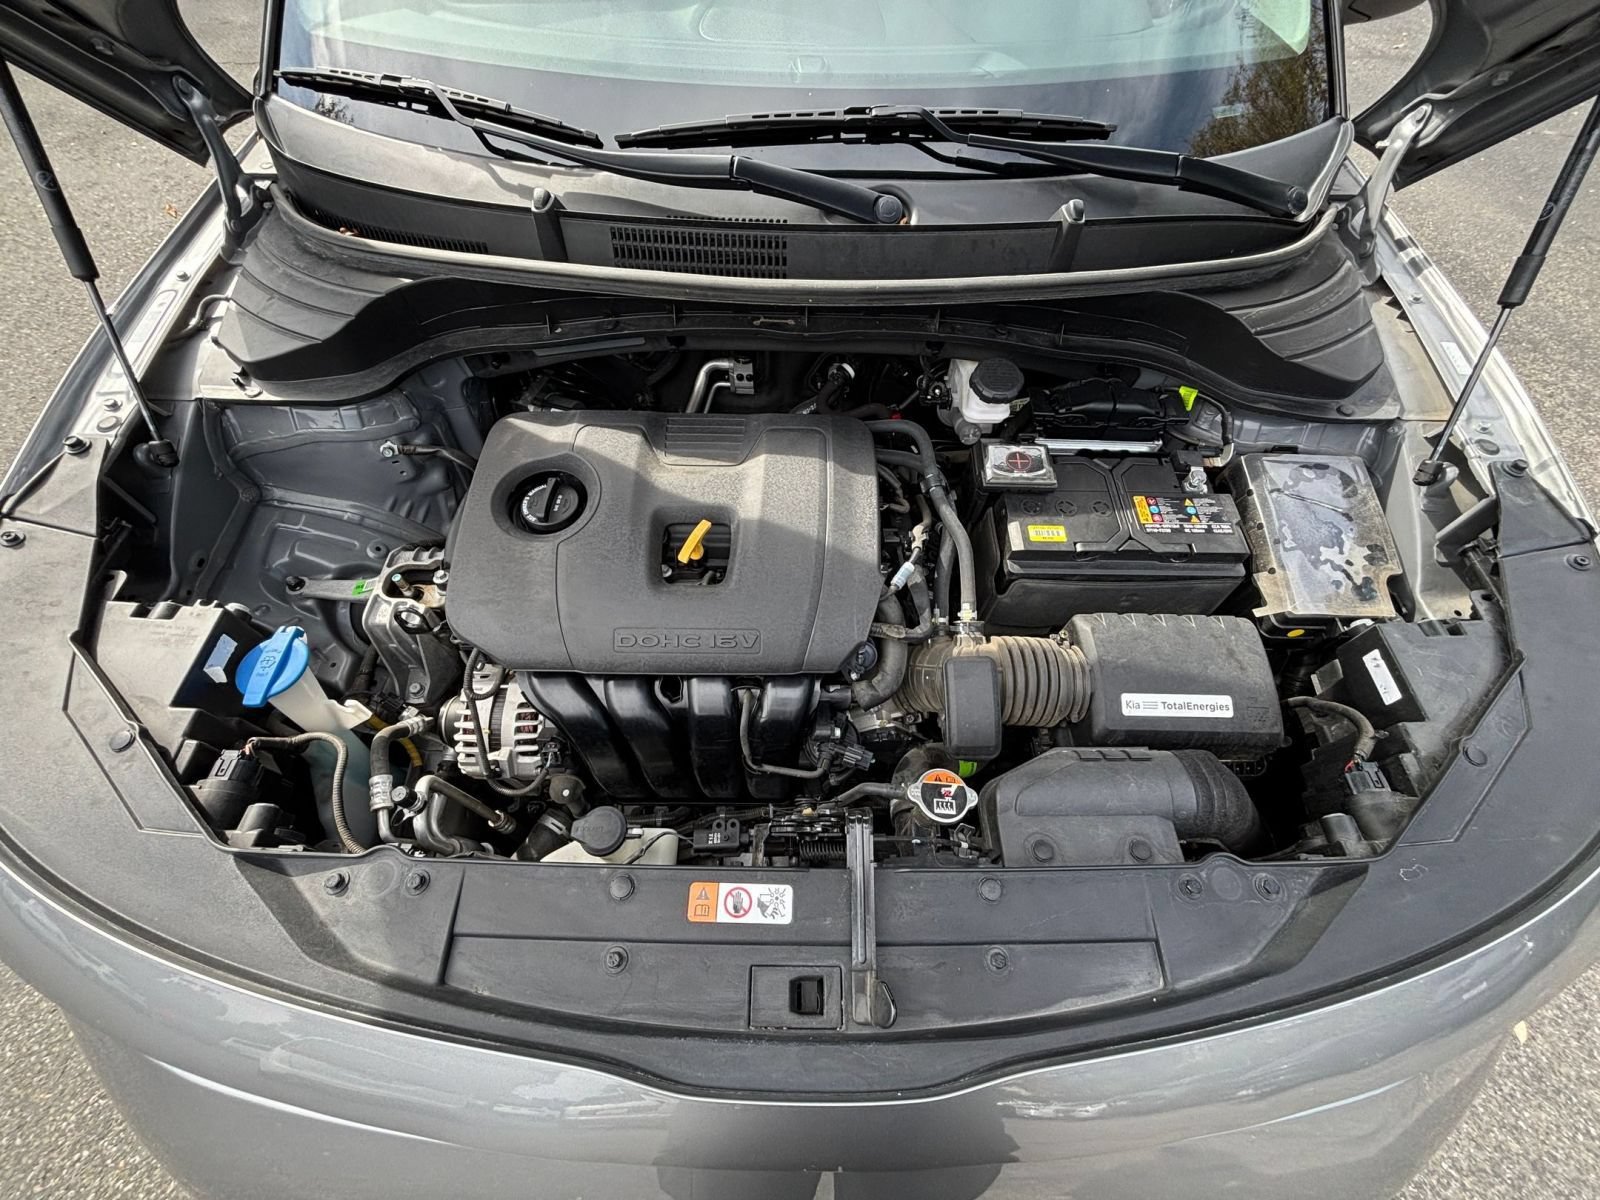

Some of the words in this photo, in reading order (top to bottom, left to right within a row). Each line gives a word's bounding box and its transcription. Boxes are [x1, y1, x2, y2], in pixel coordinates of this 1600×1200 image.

[616, 634, 701, 648] DOHC
[710, 634, 760, 648] 16V
[1125, 699, 1141, 710] Kia
[1160, 701, 1230, 712] TotalEnergies
